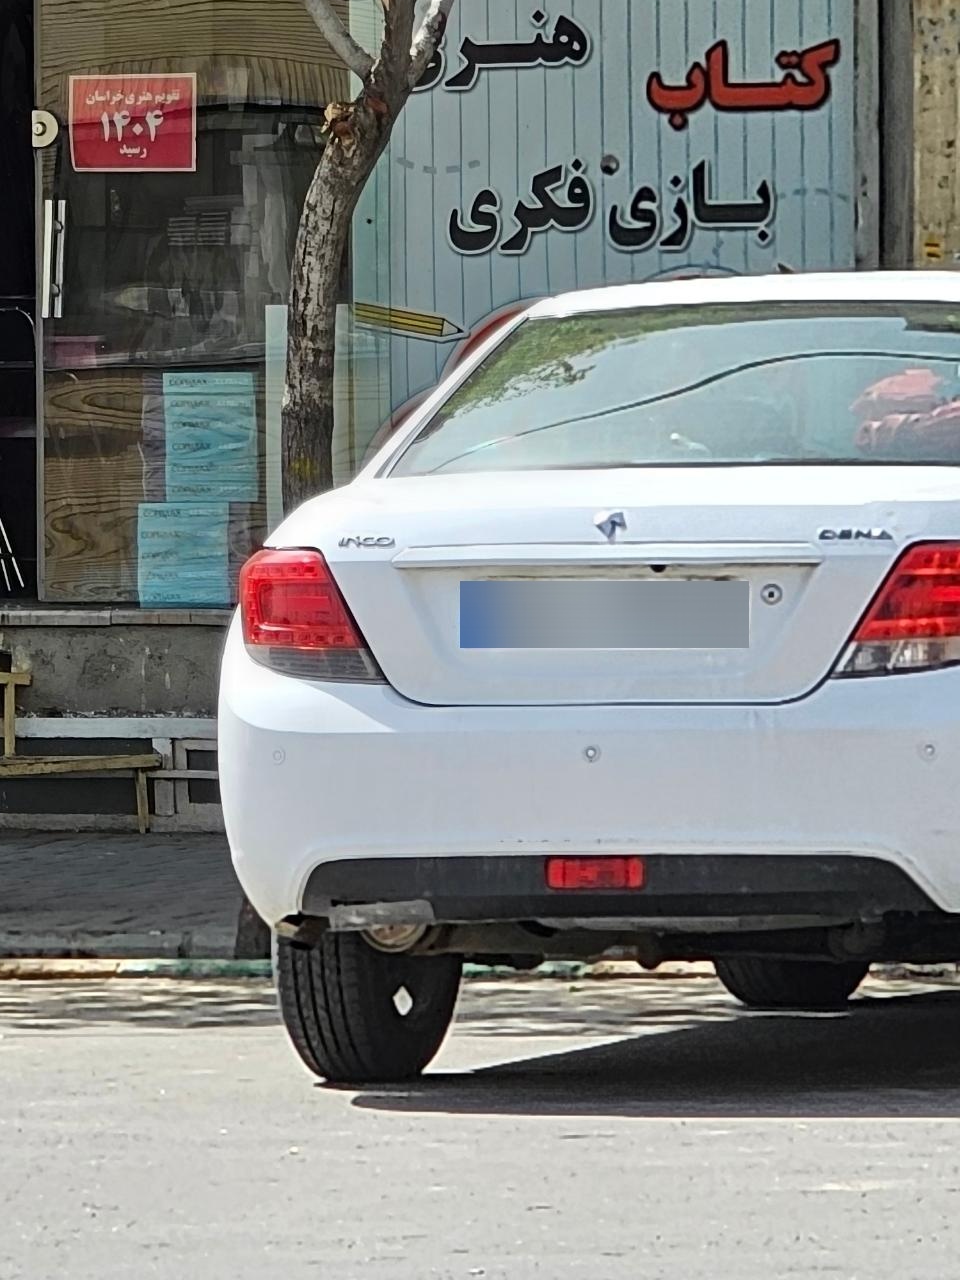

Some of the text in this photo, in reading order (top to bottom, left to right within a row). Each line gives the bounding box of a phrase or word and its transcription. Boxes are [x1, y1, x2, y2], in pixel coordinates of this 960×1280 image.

[646, 37, 840, 131] کتاب
[86, 89, 181, 105] تقویم هنری خراسان
[101, 109, 164, 143] ۱۴۰۴
[119, 143, 148, 159] رسید
[449, 158, 773, 251] بازی فکری
[818, 528, 893, 540] DENA
